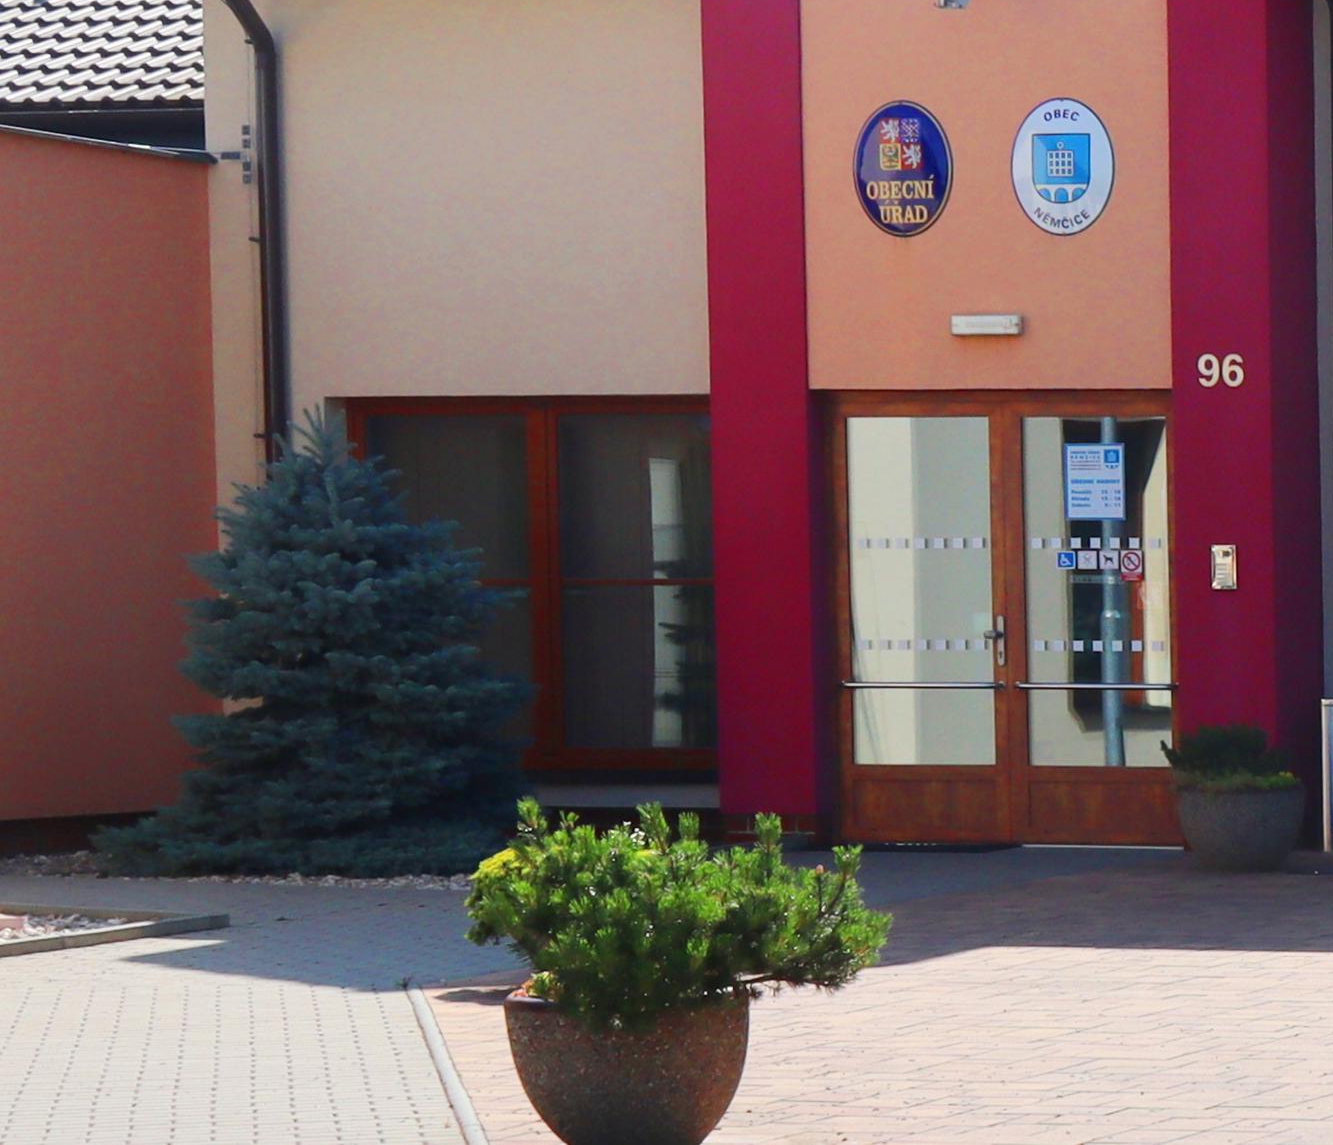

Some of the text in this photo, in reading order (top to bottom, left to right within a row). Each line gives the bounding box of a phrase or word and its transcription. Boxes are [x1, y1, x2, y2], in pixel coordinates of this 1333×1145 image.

[1043, 109, 1081, 122] OBEC
[866, 174, 934, 200] OBECNÍ
[878, 199, 928, 224] ÚŘAD
[1033, 207, 1091, 229] NĚMČICE
[1197, 353, 1244, 387] 96
